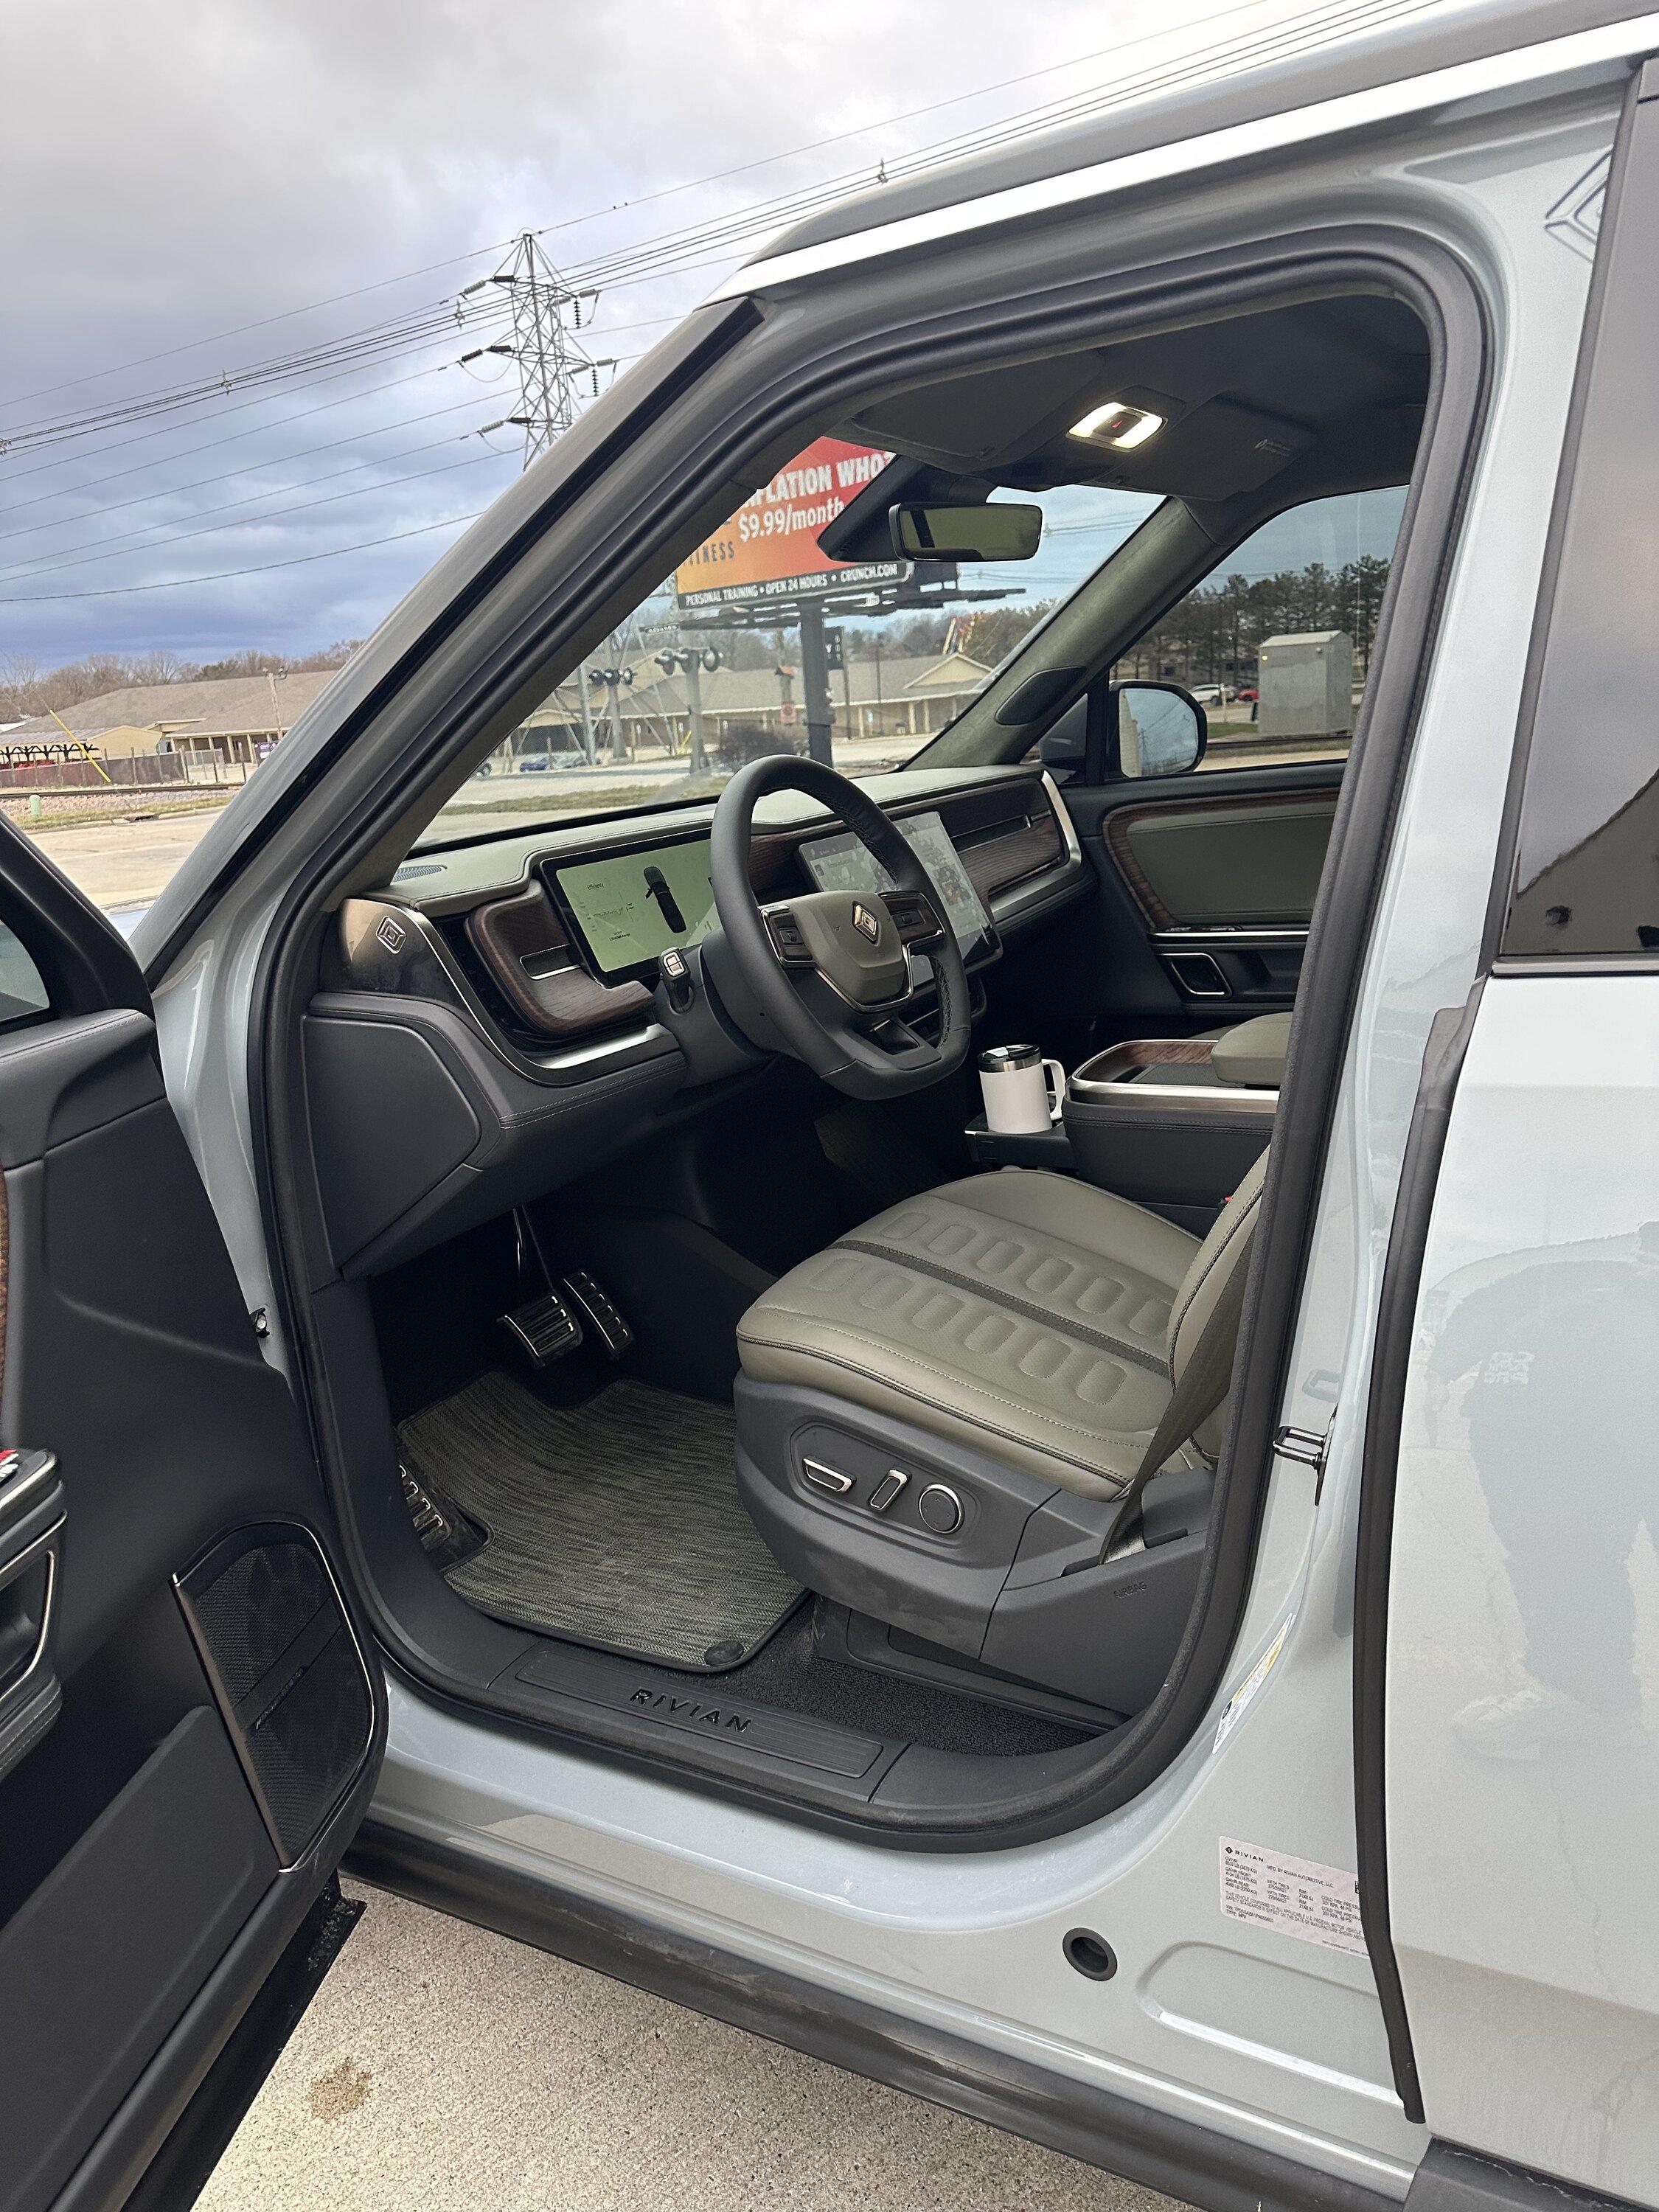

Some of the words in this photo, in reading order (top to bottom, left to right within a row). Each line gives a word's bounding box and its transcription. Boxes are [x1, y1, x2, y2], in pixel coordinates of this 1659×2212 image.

[743, 465, 832, 507] FLATION
[738, 496, 845, 542] $9.99/month
[684, 540, 734, 566] ITNESS
[685, 589, 722, 606] PERSONAL
[723, 585, 759, 601] TRAINING
[765, 580, 787, 595] OPEN
[787, 579, 799, 591] 24
[799, 574, 828, 590] HOURS
[840, 563, 898, 582] CRUNCH.COM
[1113, 1581, 1148, 1599] AIRBAG
[630, 1688, 751, 1733] RIVIAN
[1235, 1850, 1263, 1862] RIVIAN
[1343, 1902, 1360, 1910] PRESSU
